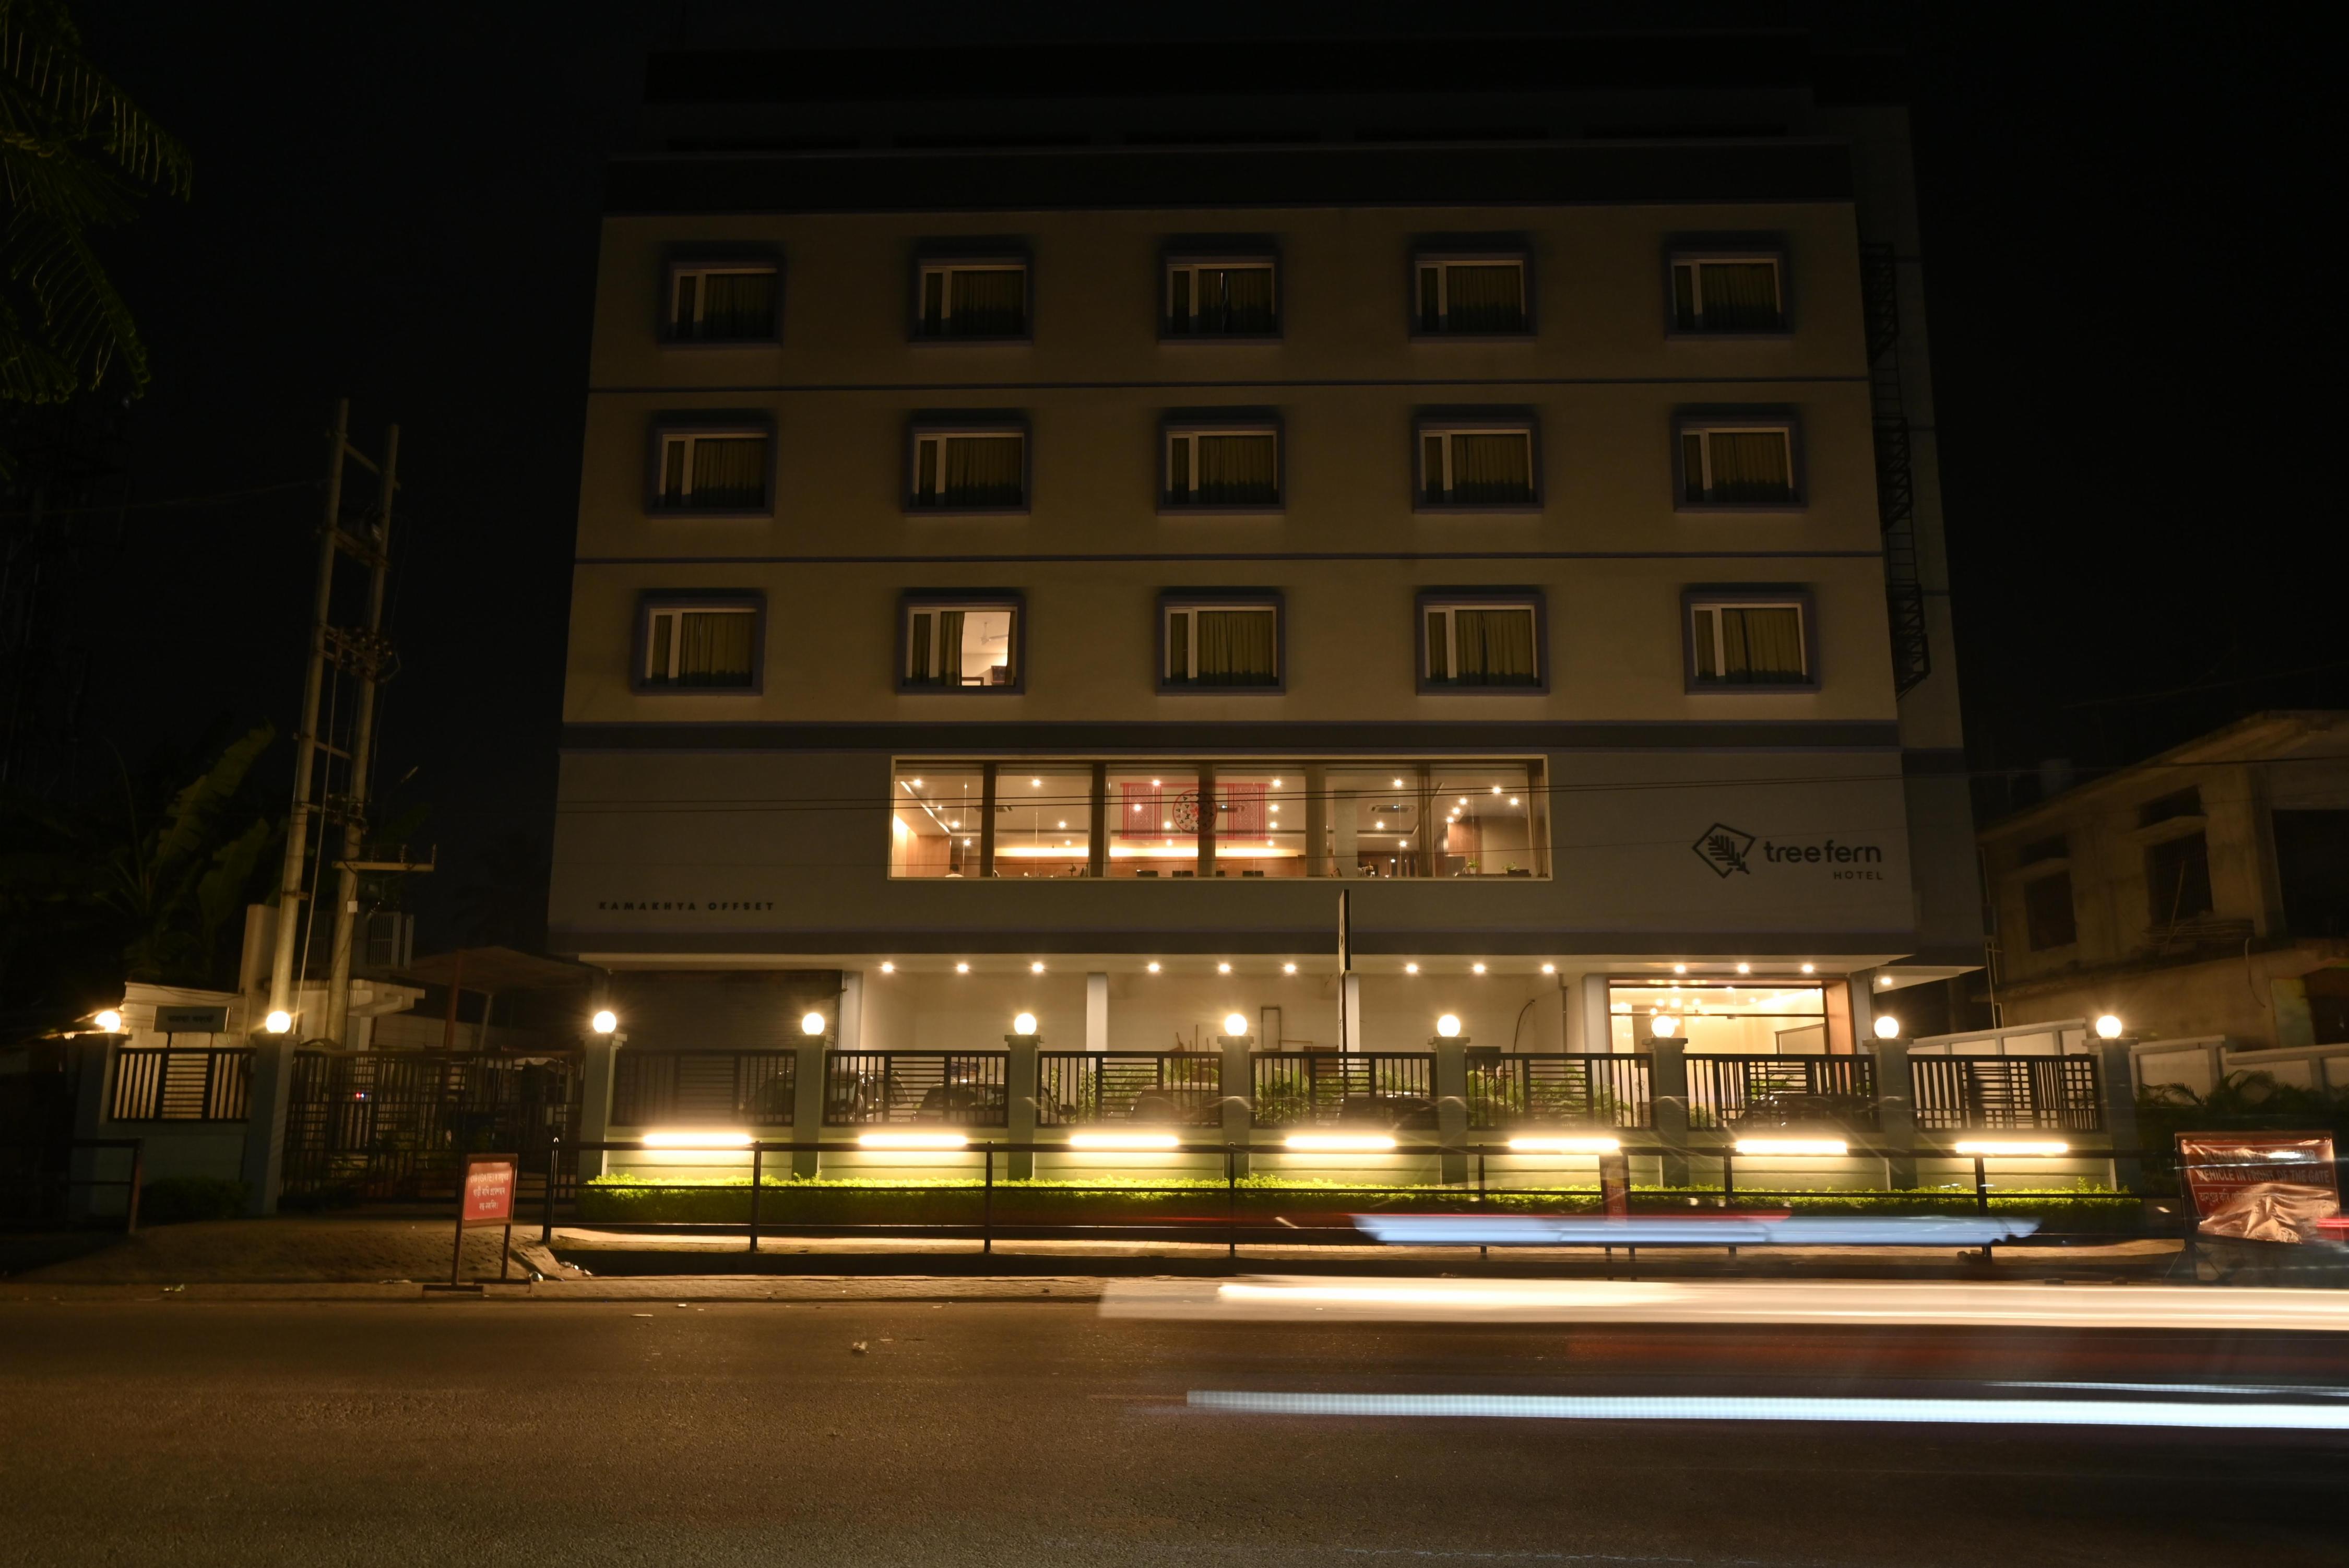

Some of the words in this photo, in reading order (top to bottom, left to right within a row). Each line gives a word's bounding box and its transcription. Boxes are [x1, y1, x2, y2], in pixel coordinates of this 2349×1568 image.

[1834, 871, 1883, 880] HOTEL
[598, 902, 696, 911] KAMAKHYA
[708, 902, 774, 911] OFFSET
[2196, 1169, 2235, 1181] VEHICLE
[2235, 1169, 2246, 1181] IN
[2245, 1169, 2274, 1182] FRONT
[2276, 1170, 2288, 1182] OF
[2289, 1170, 2306, 1182] THE
[2308, 1170, 2331, 1183] GATE
